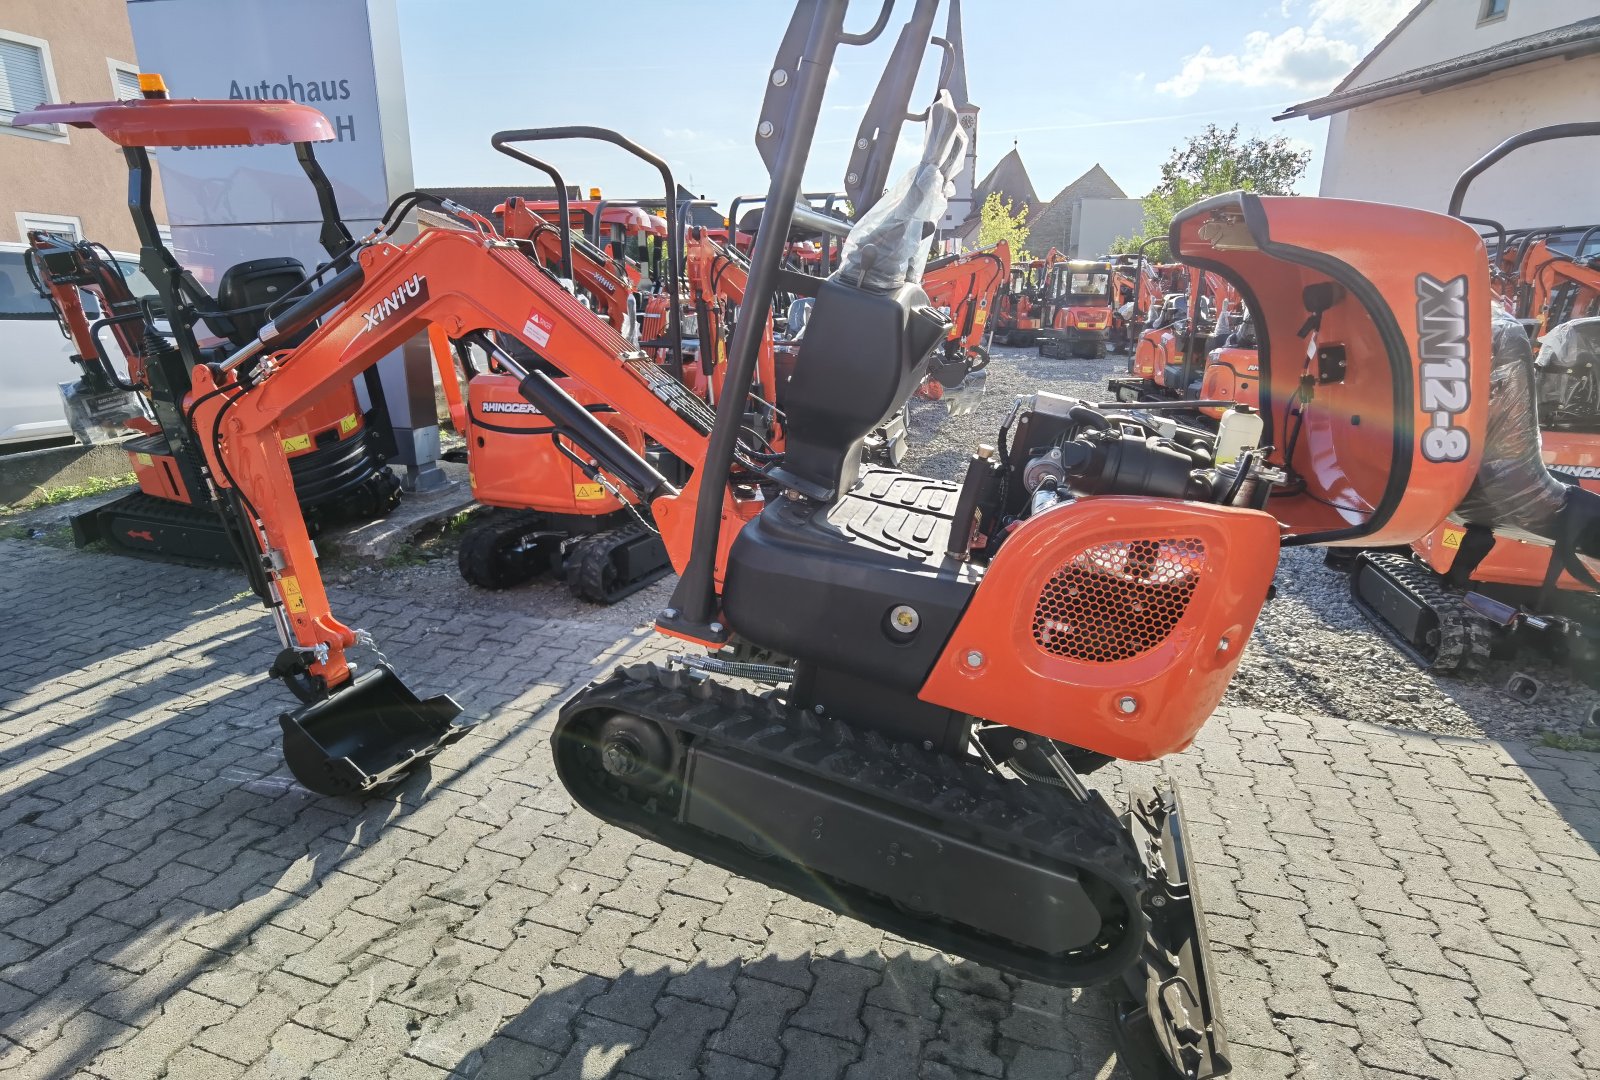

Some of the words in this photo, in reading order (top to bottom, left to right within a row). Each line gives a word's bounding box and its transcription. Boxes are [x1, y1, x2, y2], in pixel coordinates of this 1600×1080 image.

[229, 75, 351, 102] Autohaus
[362, 273, 421, 332] XINIU
[1416, 273, 1470, 463] XN12-8
